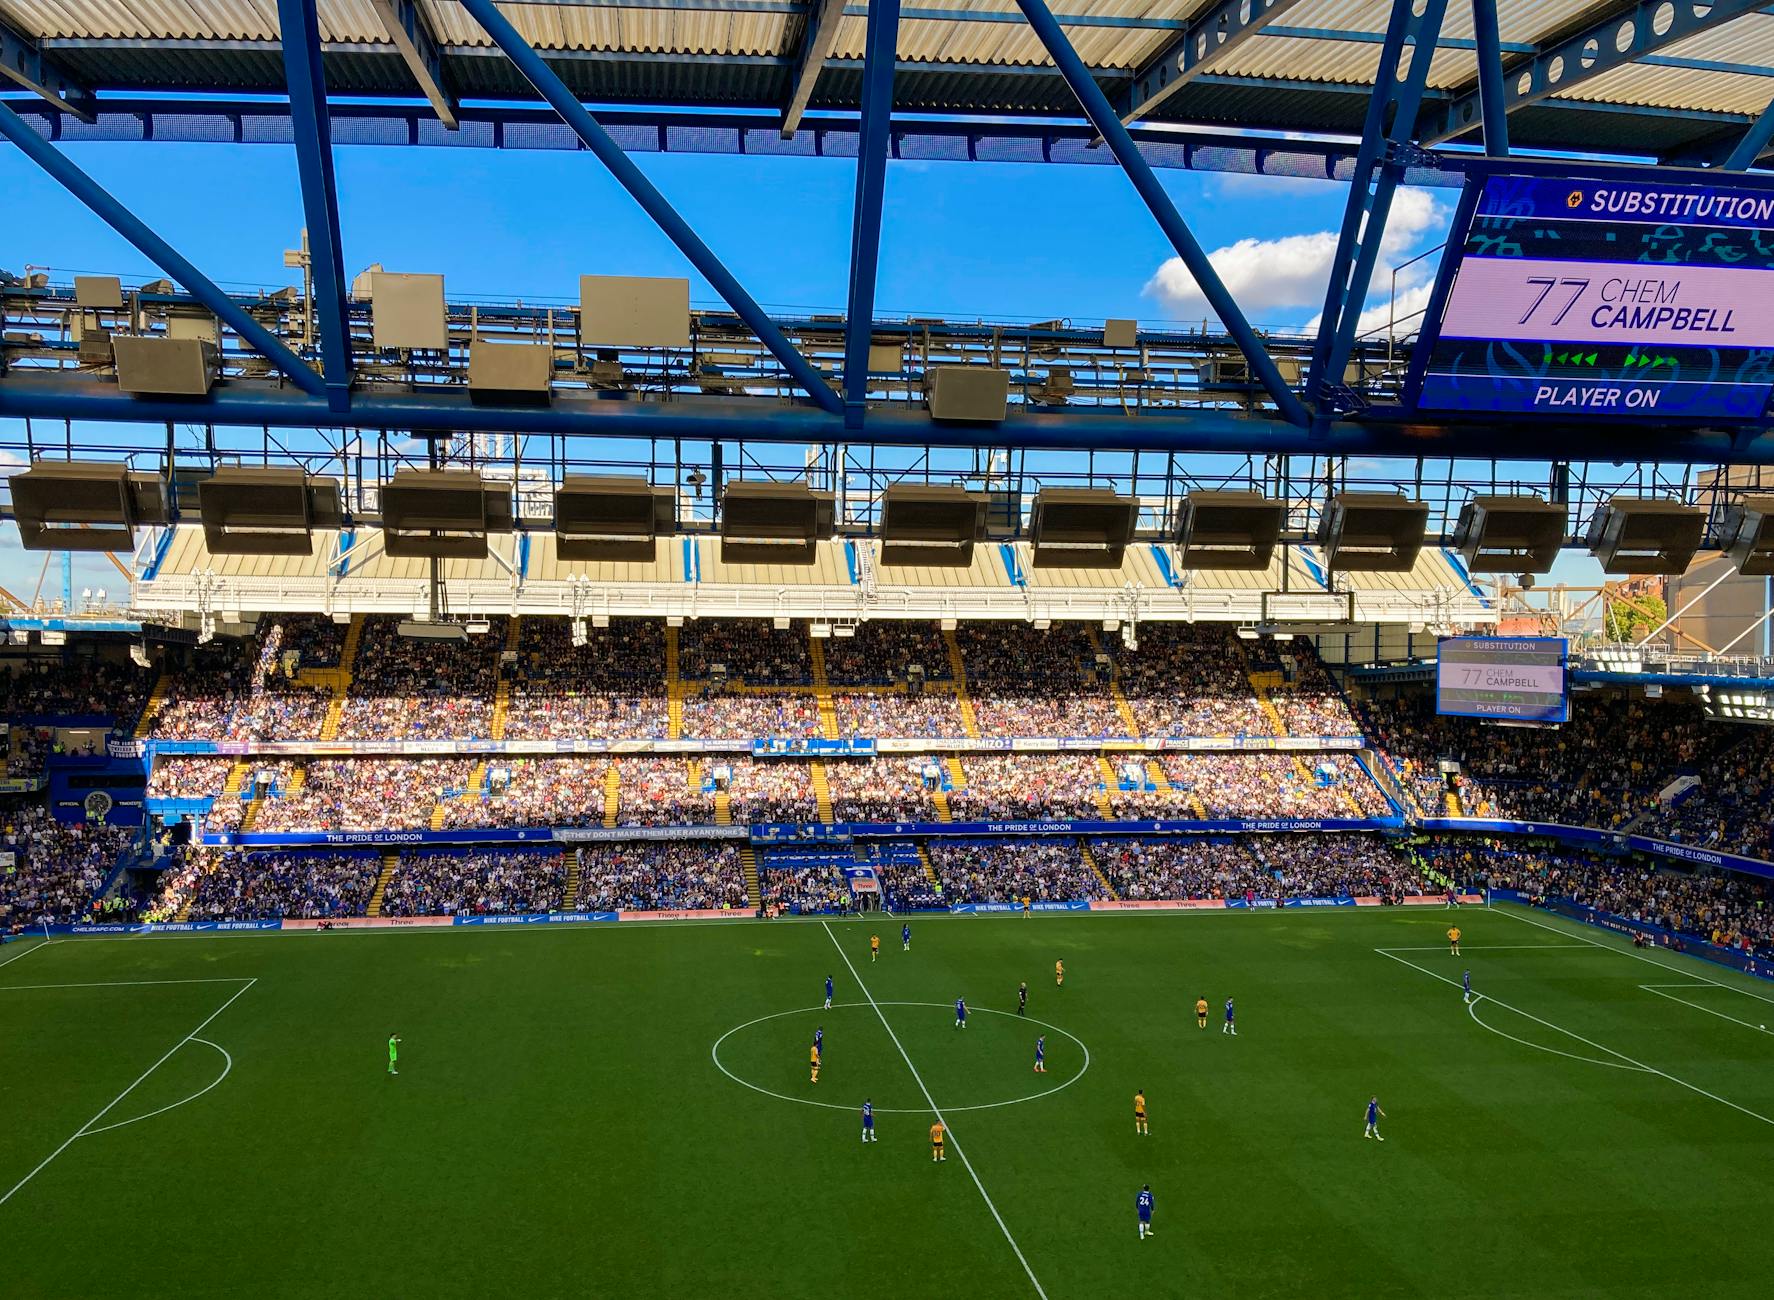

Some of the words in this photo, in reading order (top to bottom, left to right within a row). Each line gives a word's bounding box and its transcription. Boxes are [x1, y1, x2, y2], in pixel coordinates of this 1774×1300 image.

[1590, 190, 1774, 221] SUBSTITUTION
[1600, 278, 1681, 304] CHEM
[1518, 276, 1591, 326] 77
[1591, 305, 1736, 333] CAMPBELL
[1534, 386, 1620, 408] PLAYER
[1624, 389, 1661, 408] ON
[1473, 642, 1536, 650] SUBSTITUTION
[1461, 669, 1483, 685] 77
[1486, 669, 1513, 677] CHEM
[1486, 678, 1539, 688] CAMPBELL
[1476, 704, 1506, 713] PLAYER
[1508, 706, 1521, 714] ON
[976, 740, 1004, 749] MIZO
[326, 834, 343, 842] THE
[346, 834, 373, 842] PRIDE
[385, 833, 423, 841] LONDON
[1652, 843, 1664, 852] THE
[1665, 845, 1684, 856] PRIDE
[1693, 852, 1722, 864] LONDON
[1140, 1196, 1150, 1206] 24
